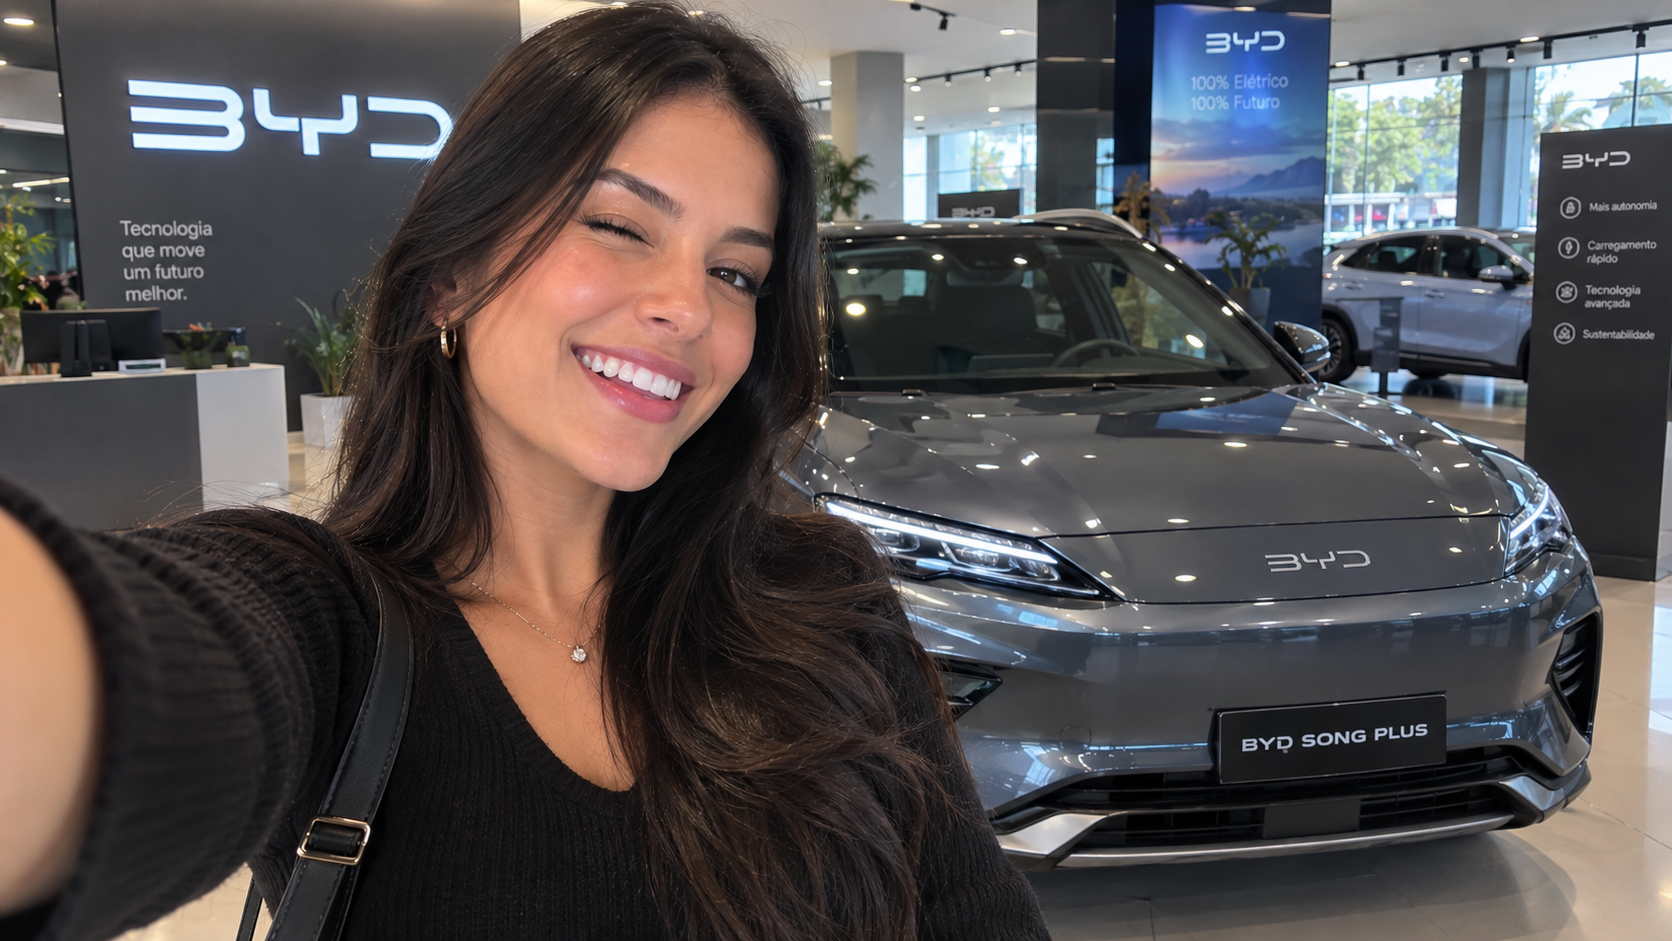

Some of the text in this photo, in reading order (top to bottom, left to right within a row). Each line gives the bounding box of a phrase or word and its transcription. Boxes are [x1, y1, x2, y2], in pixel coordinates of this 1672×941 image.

[1205, 30, 1286, 54] BYD
[1190, 73, 1289, 91] 100% Elétrico
[1190, 94, 1281, 111] 100% Futuro
[128, 79, 454, 161] BYD
[1562, 151, 1631, 169] BYD
[1589, 200, 1657, 212] Mais autonomia
[119, 220, 213, 240] Tecnologia
[122, 245, 206, 262] que move
[1587, 240, 1657, 253] Carregamento
[1586, 254, 1618, 265] rápido
[123, 263, 205, 280] um futuro
[125, 285, 187, 302] melhor.
[1585, 284, 1641, 297] Tecnologia
[1584, 298, 1631, 310] avançada
[1582, 329, 1655, 341] Sustentabilidade
[1264, 549, 1371, 573] BYD
[1241, 723, 1429, 752] BYD SONG PLUS
